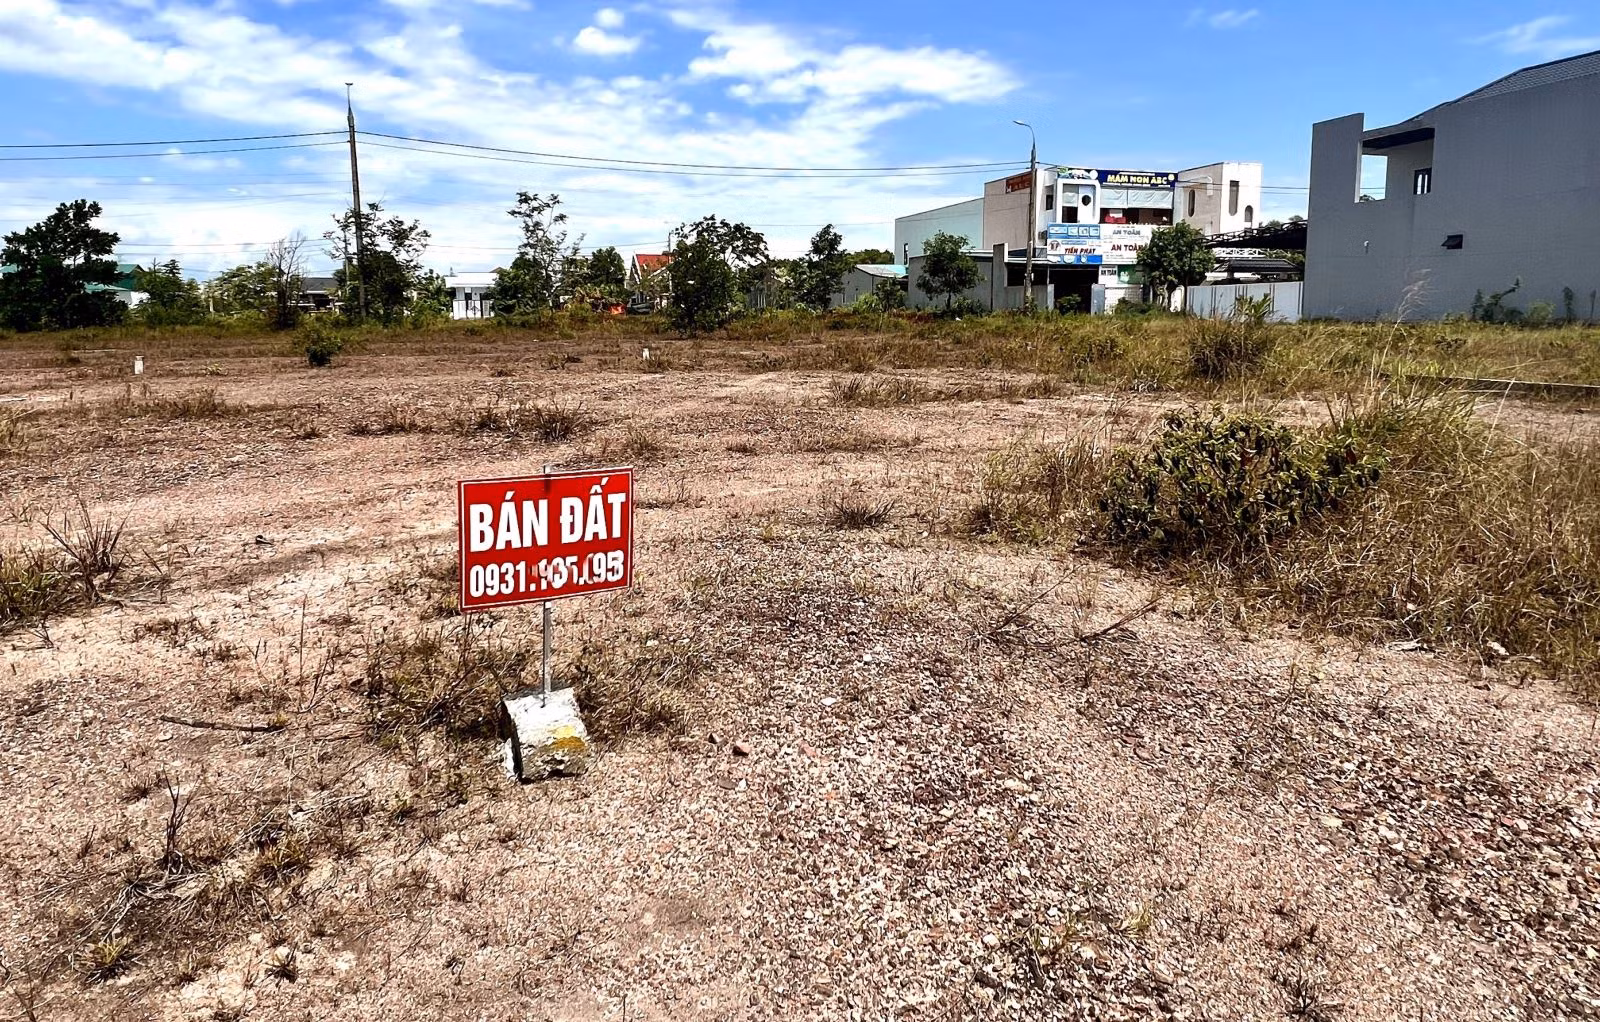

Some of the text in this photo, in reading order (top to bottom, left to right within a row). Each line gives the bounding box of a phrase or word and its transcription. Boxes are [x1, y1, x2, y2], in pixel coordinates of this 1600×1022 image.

[1129, 175, 1149, 184] NON
[1150, 176, 1168, 185] ABC
[1111, 244, 1122, 252] AN
[469, 476, 627, 553] BÁN ĐẤT
